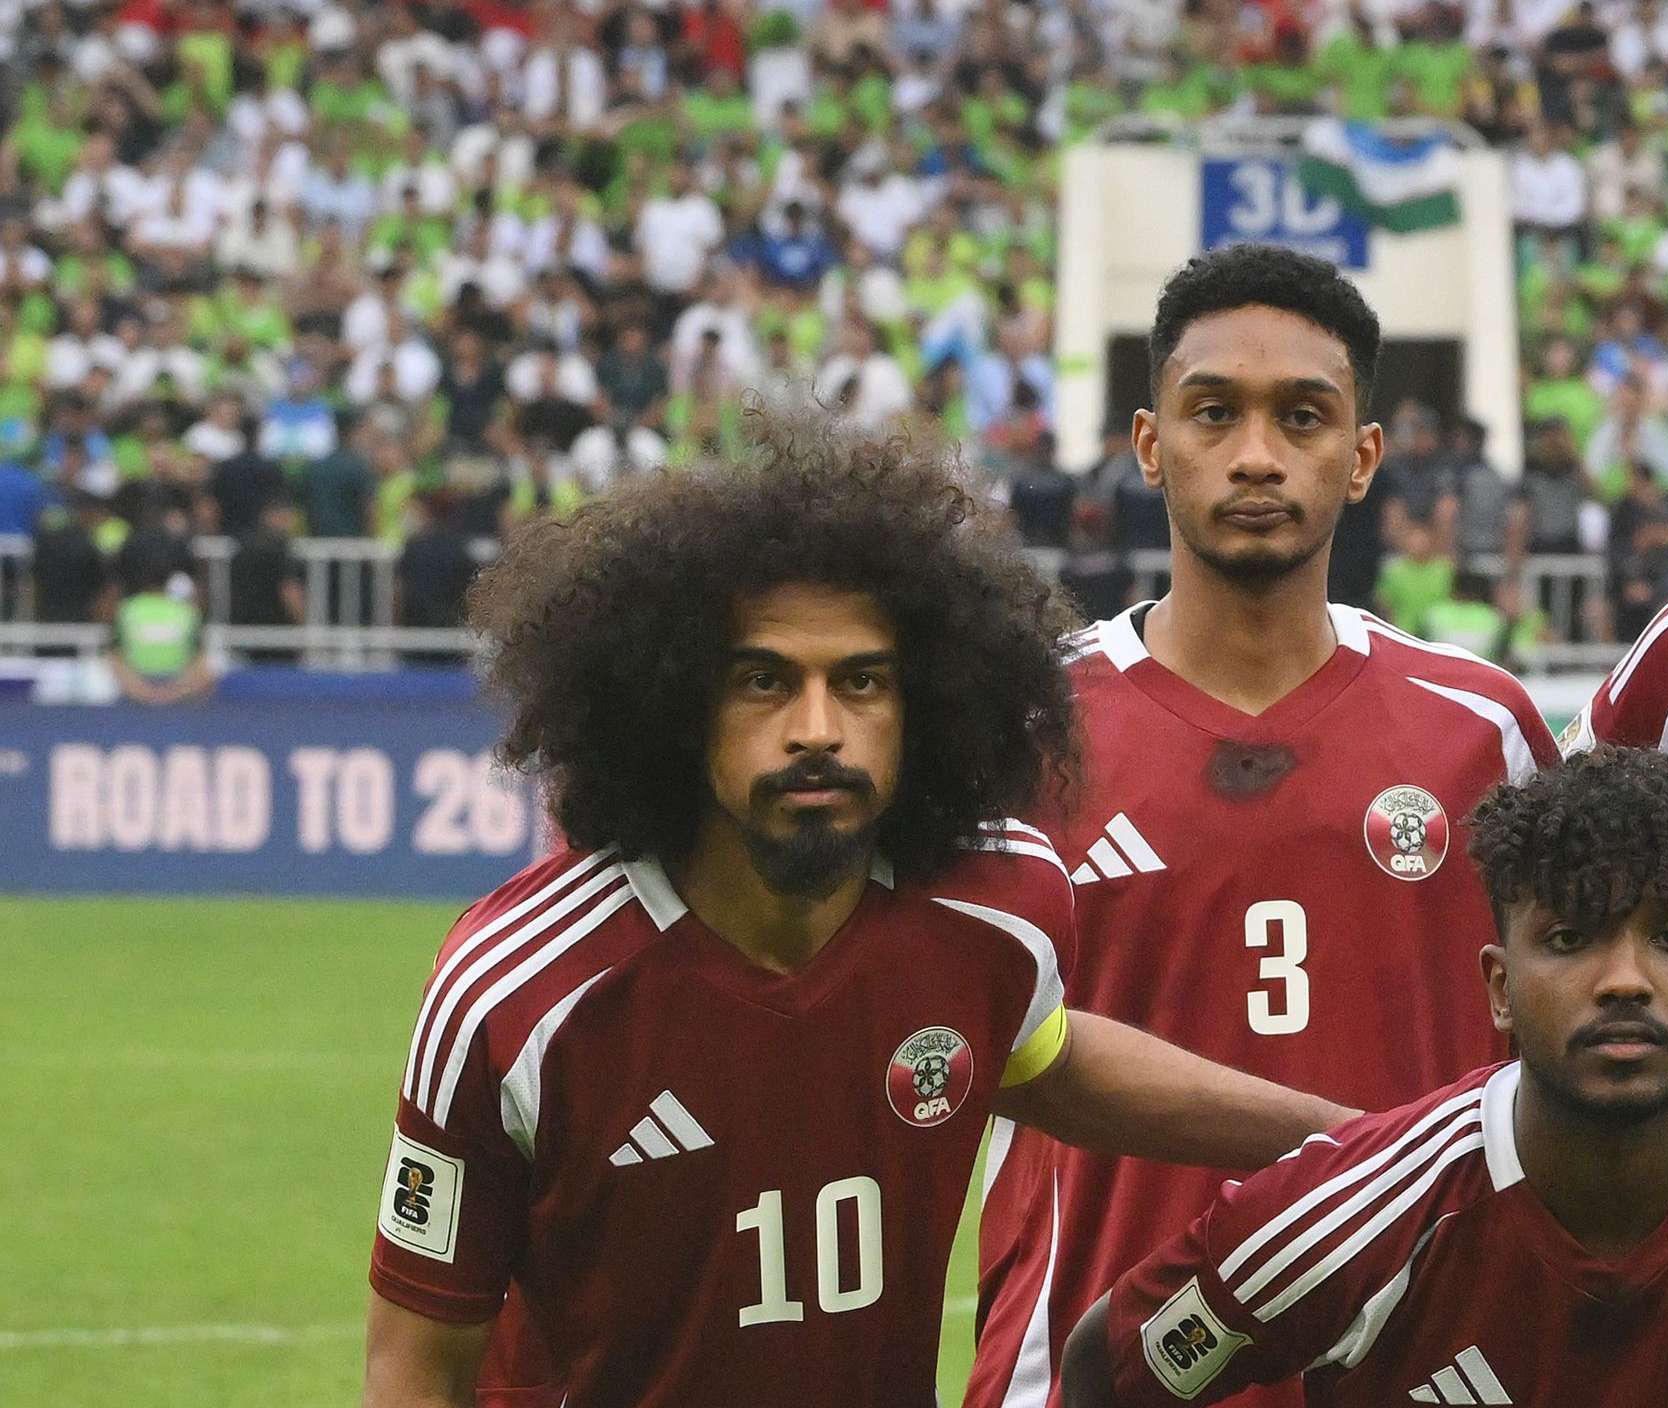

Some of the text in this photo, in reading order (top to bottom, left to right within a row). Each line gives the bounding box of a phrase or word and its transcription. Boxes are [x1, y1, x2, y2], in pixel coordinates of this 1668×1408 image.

[48, 743, 531, 857] ROAD TO 26
[1390, 853, 1427, 873] QFA
[1243, 899, 1311, 1036] 3
[913, 1096, 952, 1120] QFA
[736, 1175, 884, 1328] 10
